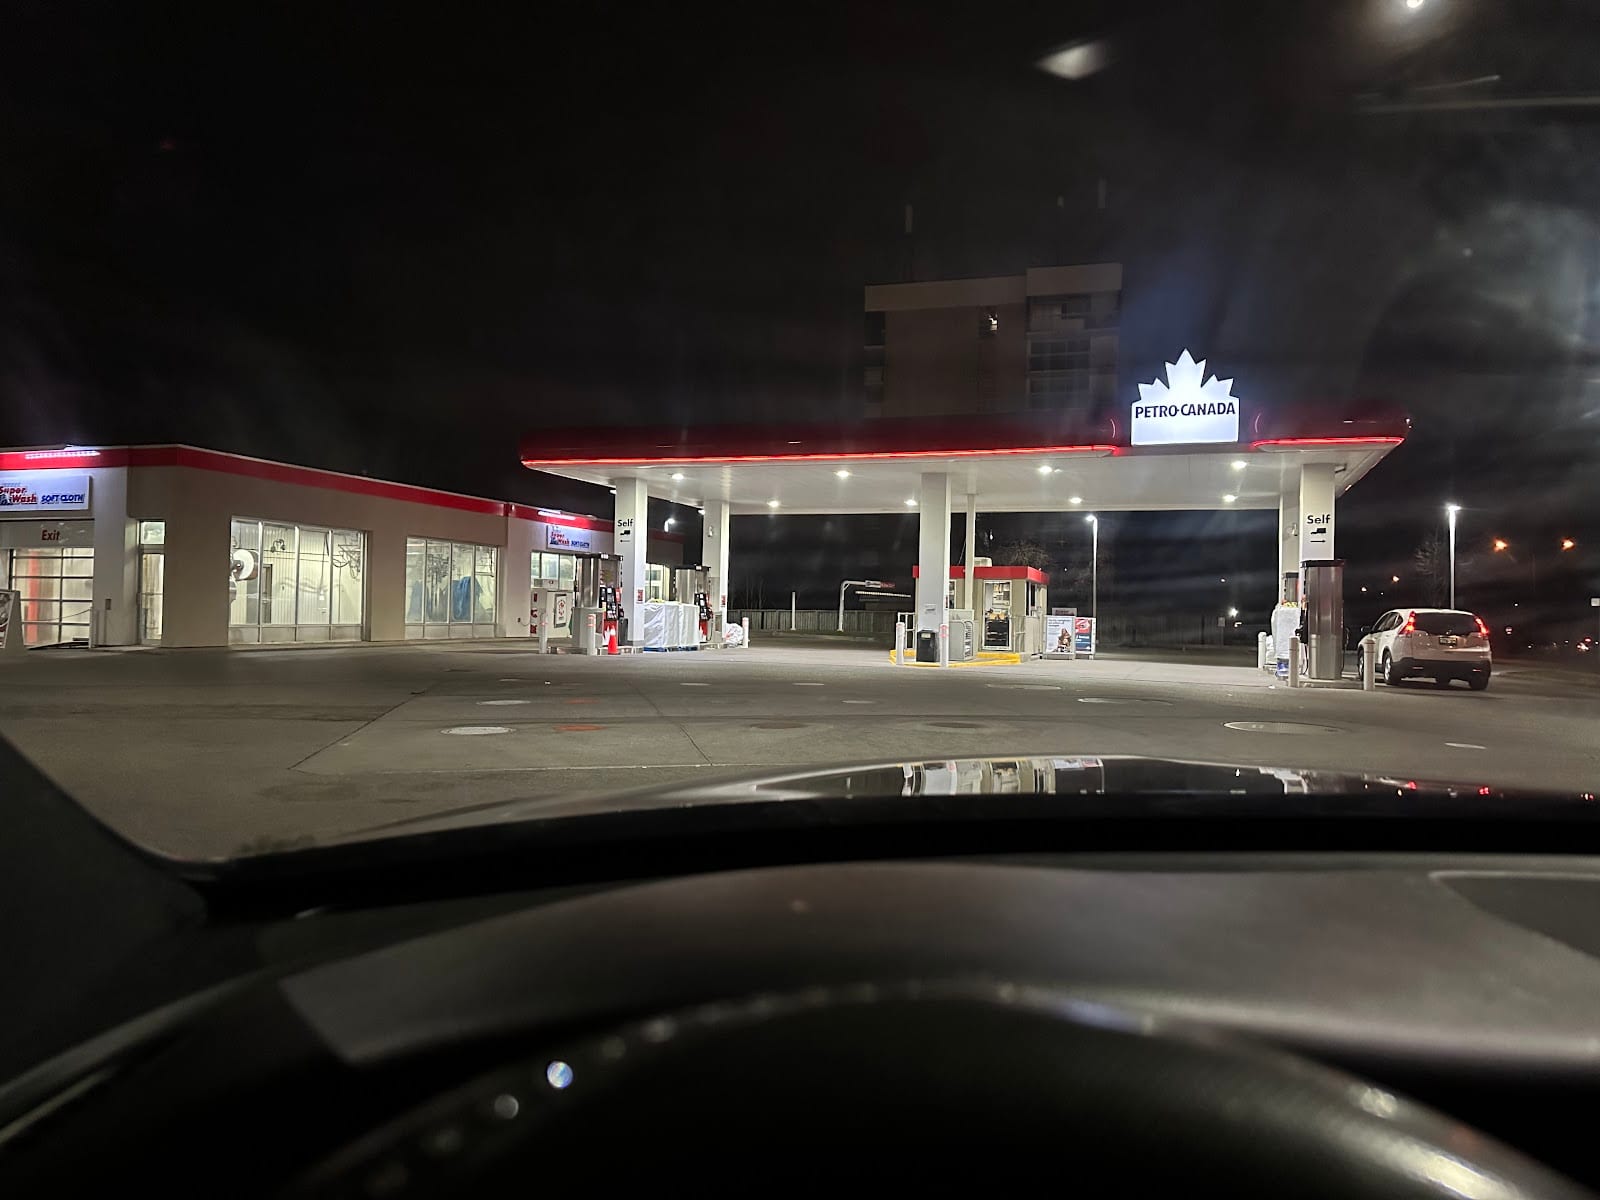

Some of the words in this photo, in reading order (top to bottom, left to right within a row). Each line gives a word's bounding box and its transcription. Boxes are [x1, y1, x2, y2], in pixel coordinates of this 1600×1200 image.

[11, 493, 37, 504] Wash
[617, 518, 634, 528] Self
[1306, 513, 1332, 524] Self
[41, 529, 60, 541] Exit
